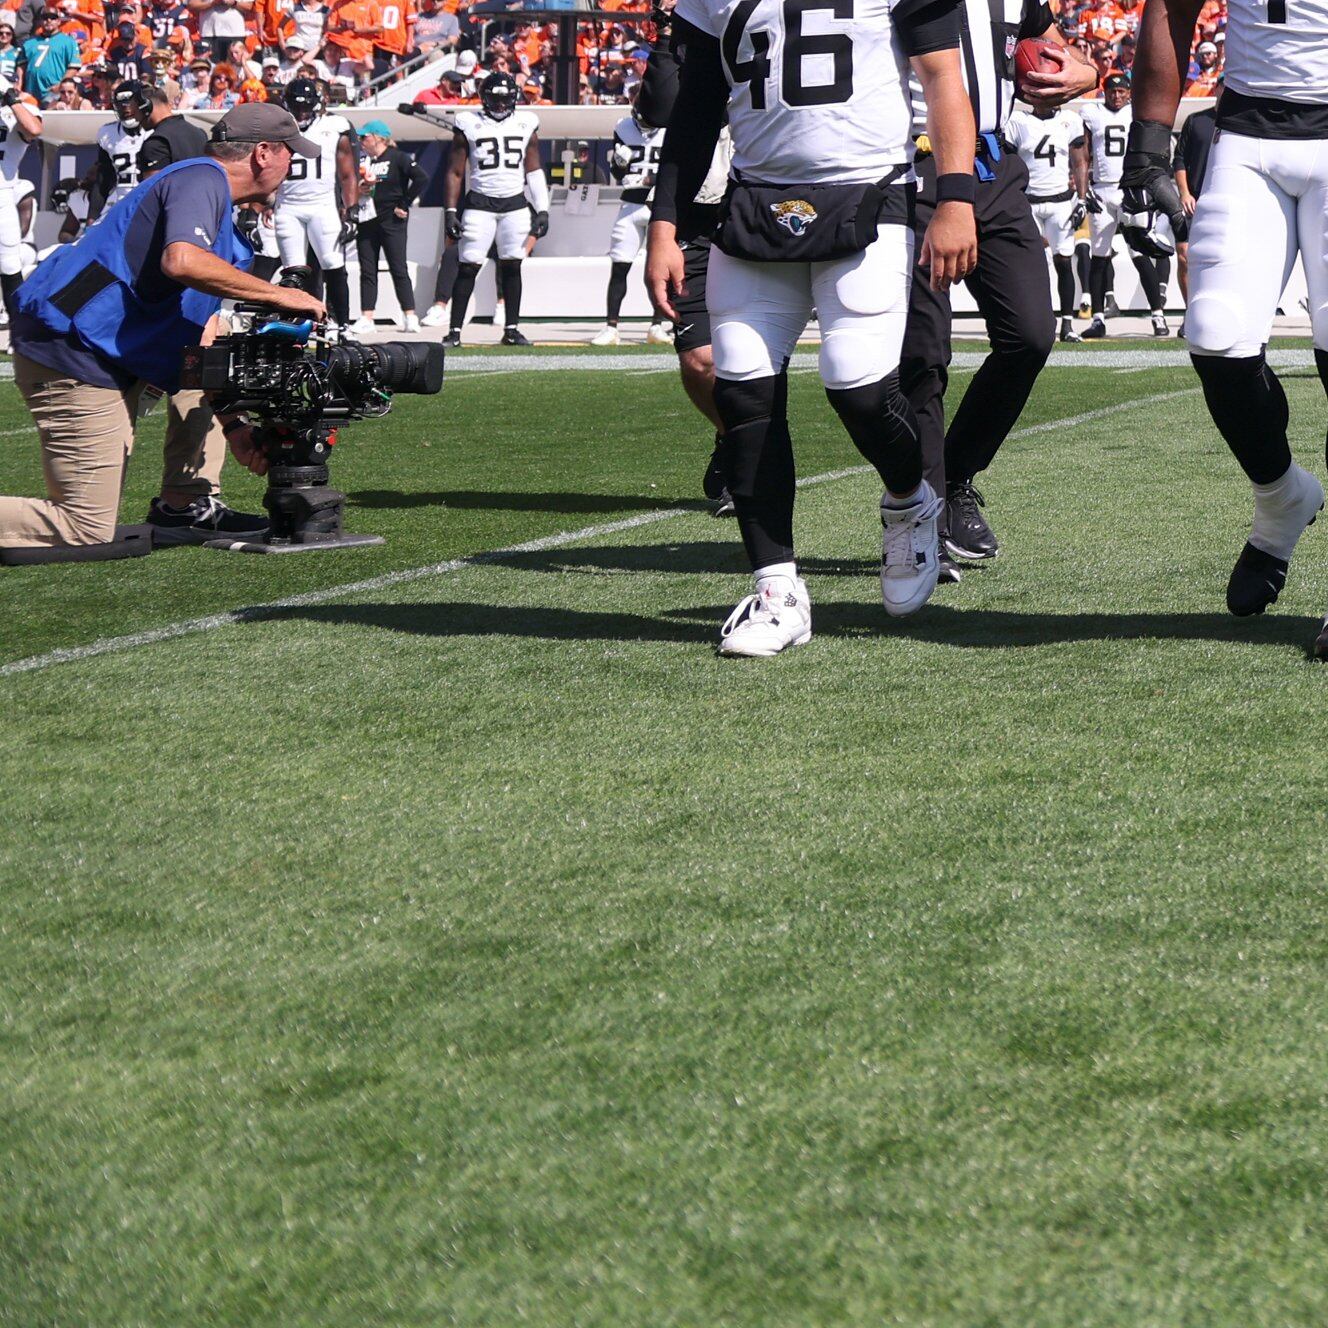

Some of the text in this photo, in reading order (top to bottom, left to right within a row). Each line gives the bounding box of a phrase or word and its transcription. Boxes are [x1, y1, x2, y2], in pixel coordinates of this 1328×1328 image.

[34, 44, 49, 67] 7
[475, 136, 524, 171] 35
[1033, 134, 1056, 168] 4
[1104, 124, 1126, 157] 6
